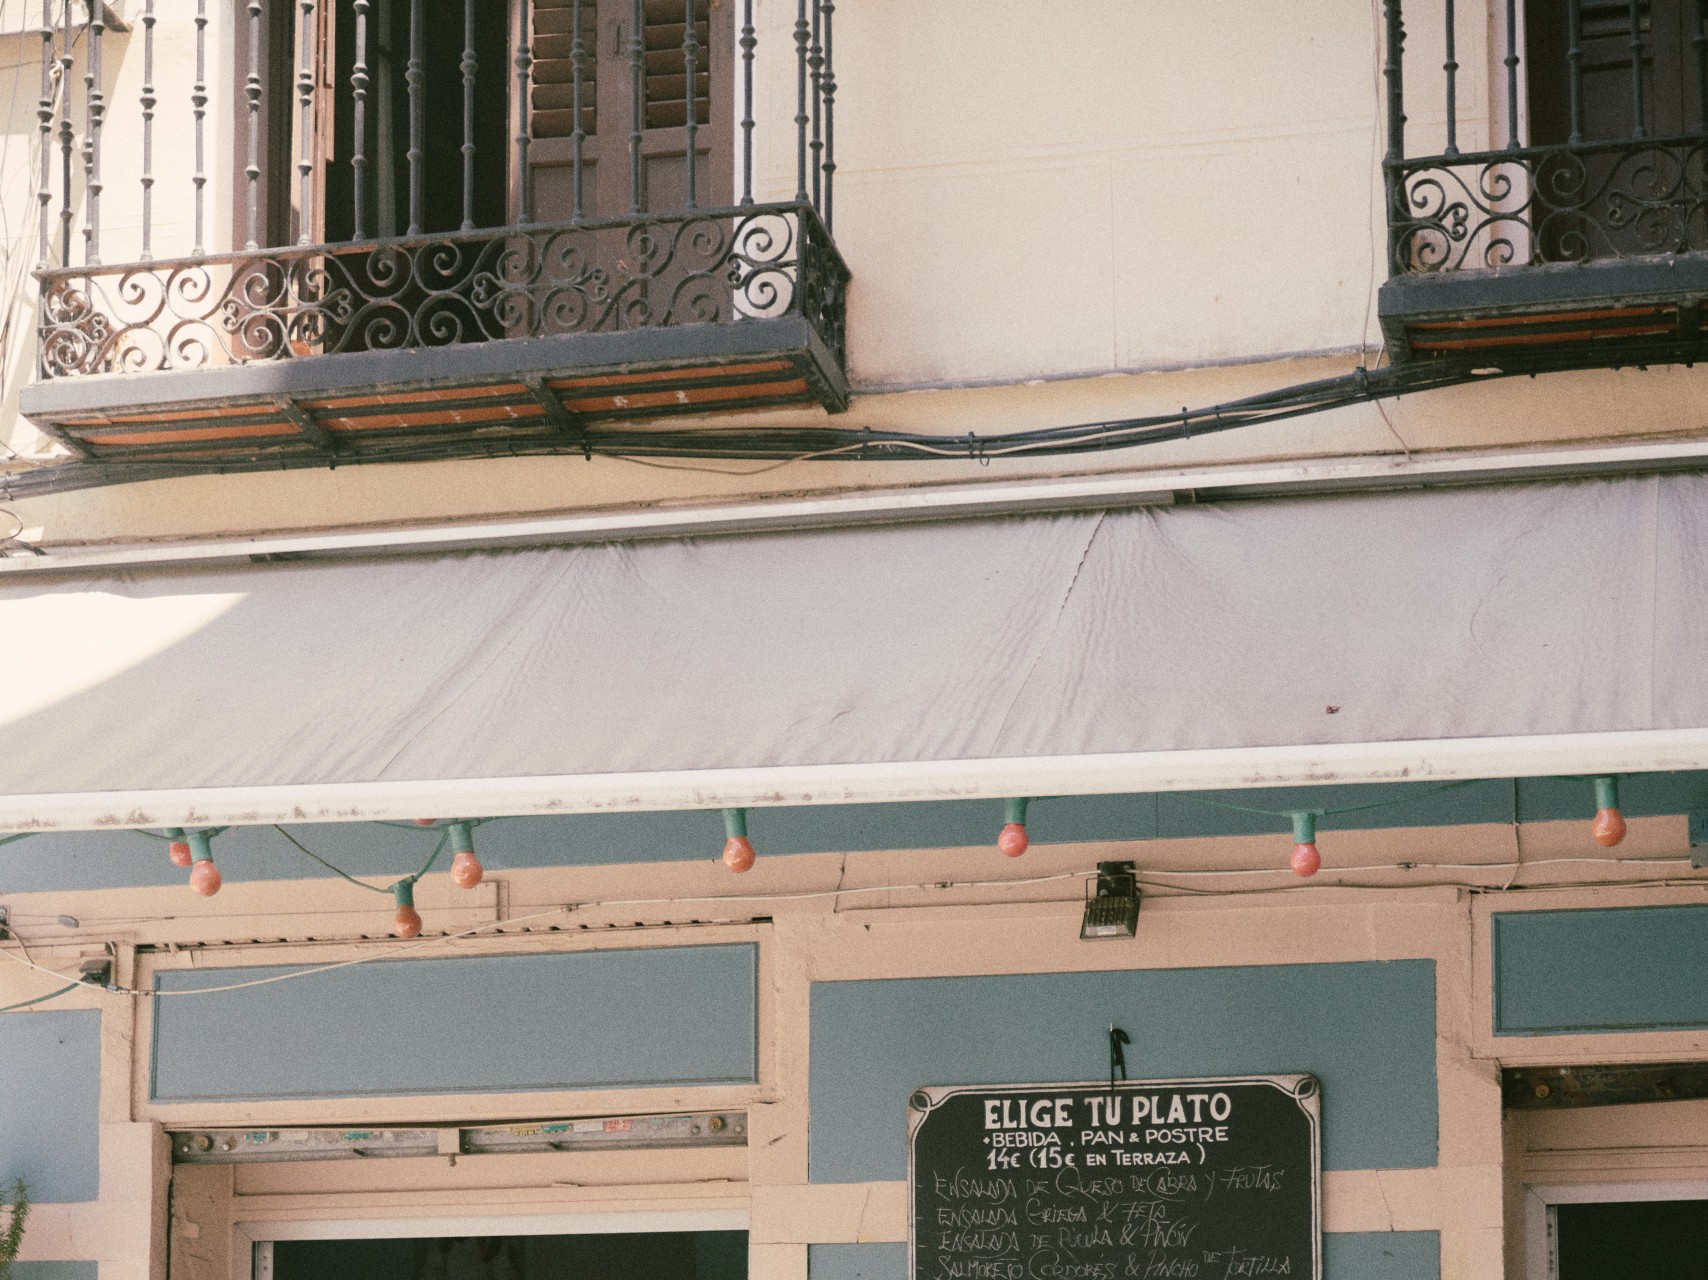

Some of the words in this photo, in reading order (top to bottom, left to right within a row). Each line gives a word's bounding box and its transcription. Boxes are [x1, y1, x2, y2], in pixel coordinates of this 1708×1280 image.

[984, 1098, 1073, 1129] ELIGE
[1084, 1096, 1122, 1127] TU
[1132, 1092, 1232, 1125] PLATO
[1081, 1130, 1124, 1145] PAN
[1129, 1133, 1140, 1143] &
[1145, 1126, 1229, 1144] POSTRE
[987, 1147, 1021, 1170] 14€
[1029, 1147, 1076, 1169] (15€
[1086, 1154, 1106, 1166] EN
[933, 1166, 1017, 1205] ENSALADA
[1026, 1178, 1050, 1195] DE
[1055, 1166, 1124, 1204] QUESO
[1130, 1175, 1147, 1192] DE
[1147, 1167, 1197, 1201] CABRA
[1220, 1165, 1284, 1192] FRUTAS
[937, 1203, 1018, 1231] ENSALADA
[1025, 1198, 1087, 1226] GRIEGA
[1097, 1201, 1119, 1223] &
[1120, 1200, 1166, 1221] FETA
[938, 1230, 1020, 1257] ENSALADA
[1030, 1235, 1050, 1248] DE
[1120, 1223, 1139, 1246] &
[1125, 1252, 1139, 1276] &
[1144, 1249, 1198, 1279] PINCHO
[1204, 1251, 1221, 1262] DE
